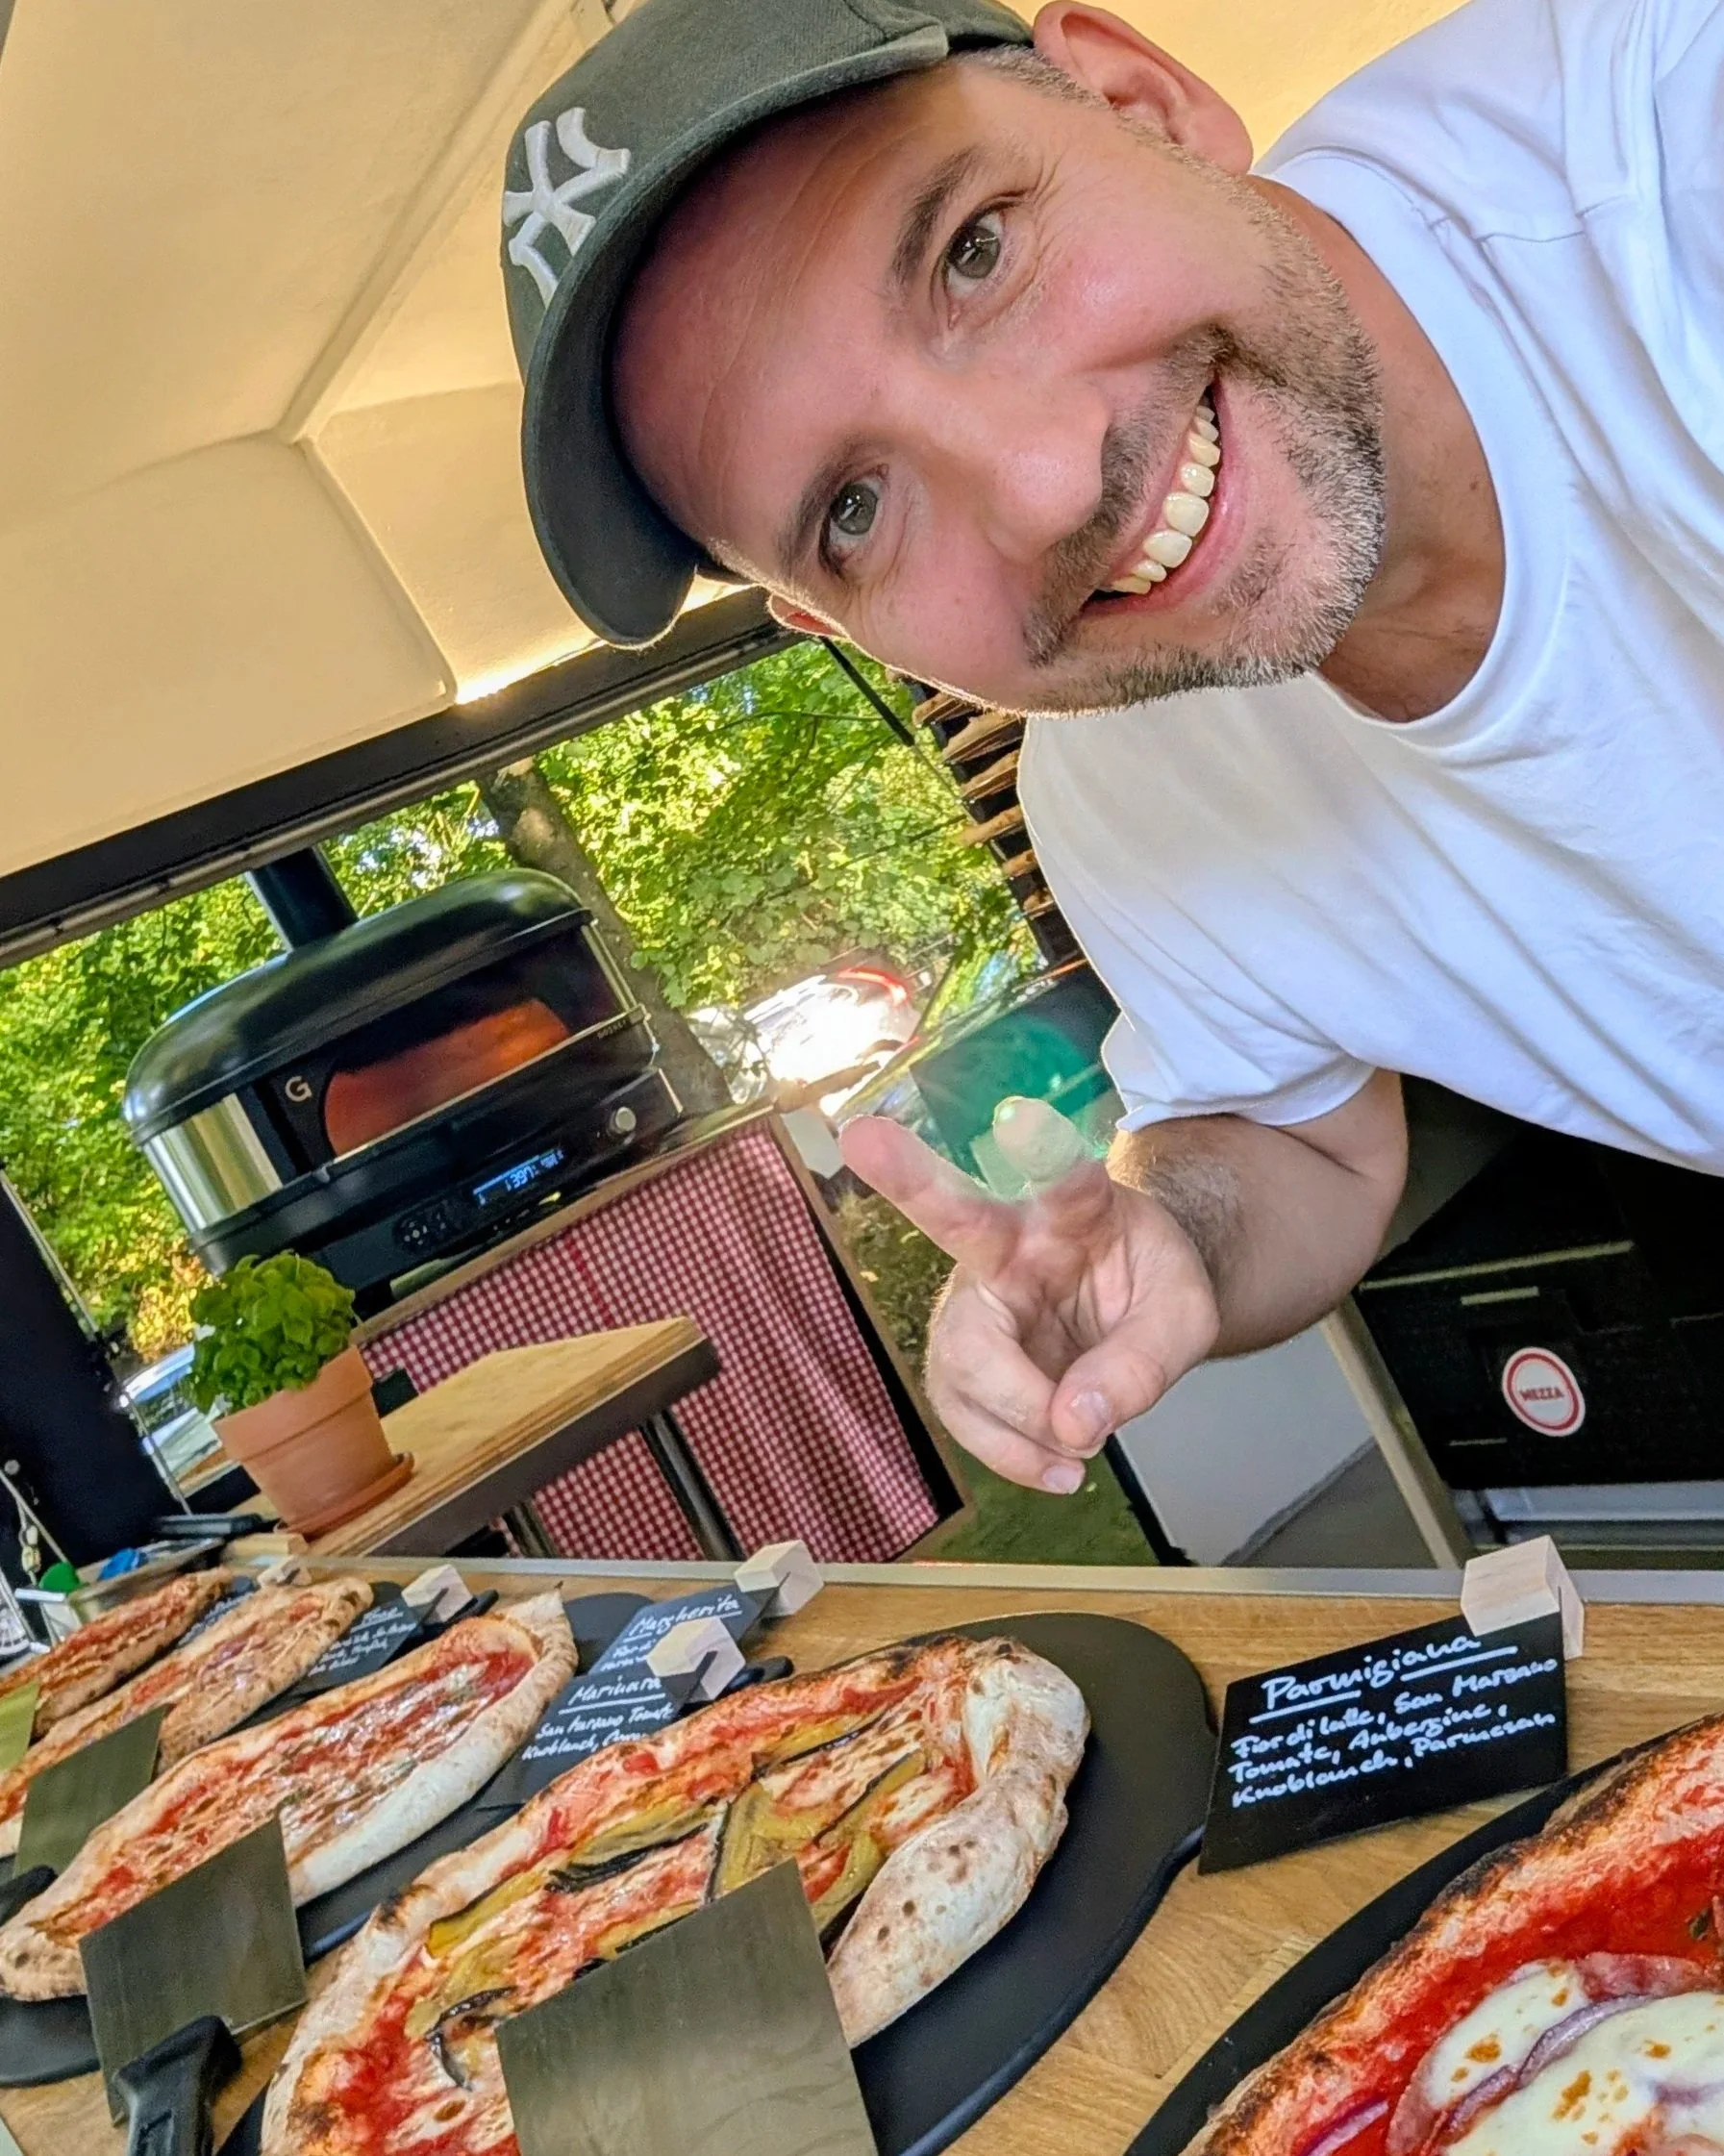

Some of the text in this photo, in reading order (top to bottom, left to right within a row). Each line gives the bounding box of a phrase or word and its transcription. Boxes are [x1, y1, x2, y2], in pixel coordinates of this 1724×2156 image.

[285, 1075, 312, 1102] G
[628, 1593, 739, 1635] Margherita
[568, 1675, 662, 1705] Marinara
[1262, 1636, 1482, 1711] Parmigiana
[1393, 1691, 1442, 1715] San
[1452, 1658, 1559, 1697] Marzano
[535, 1722, 564, 1741] San
[1410, 1713, 1557, 1757] Parmesan
[1227, 1746, 1341, 1784] Tomate,
